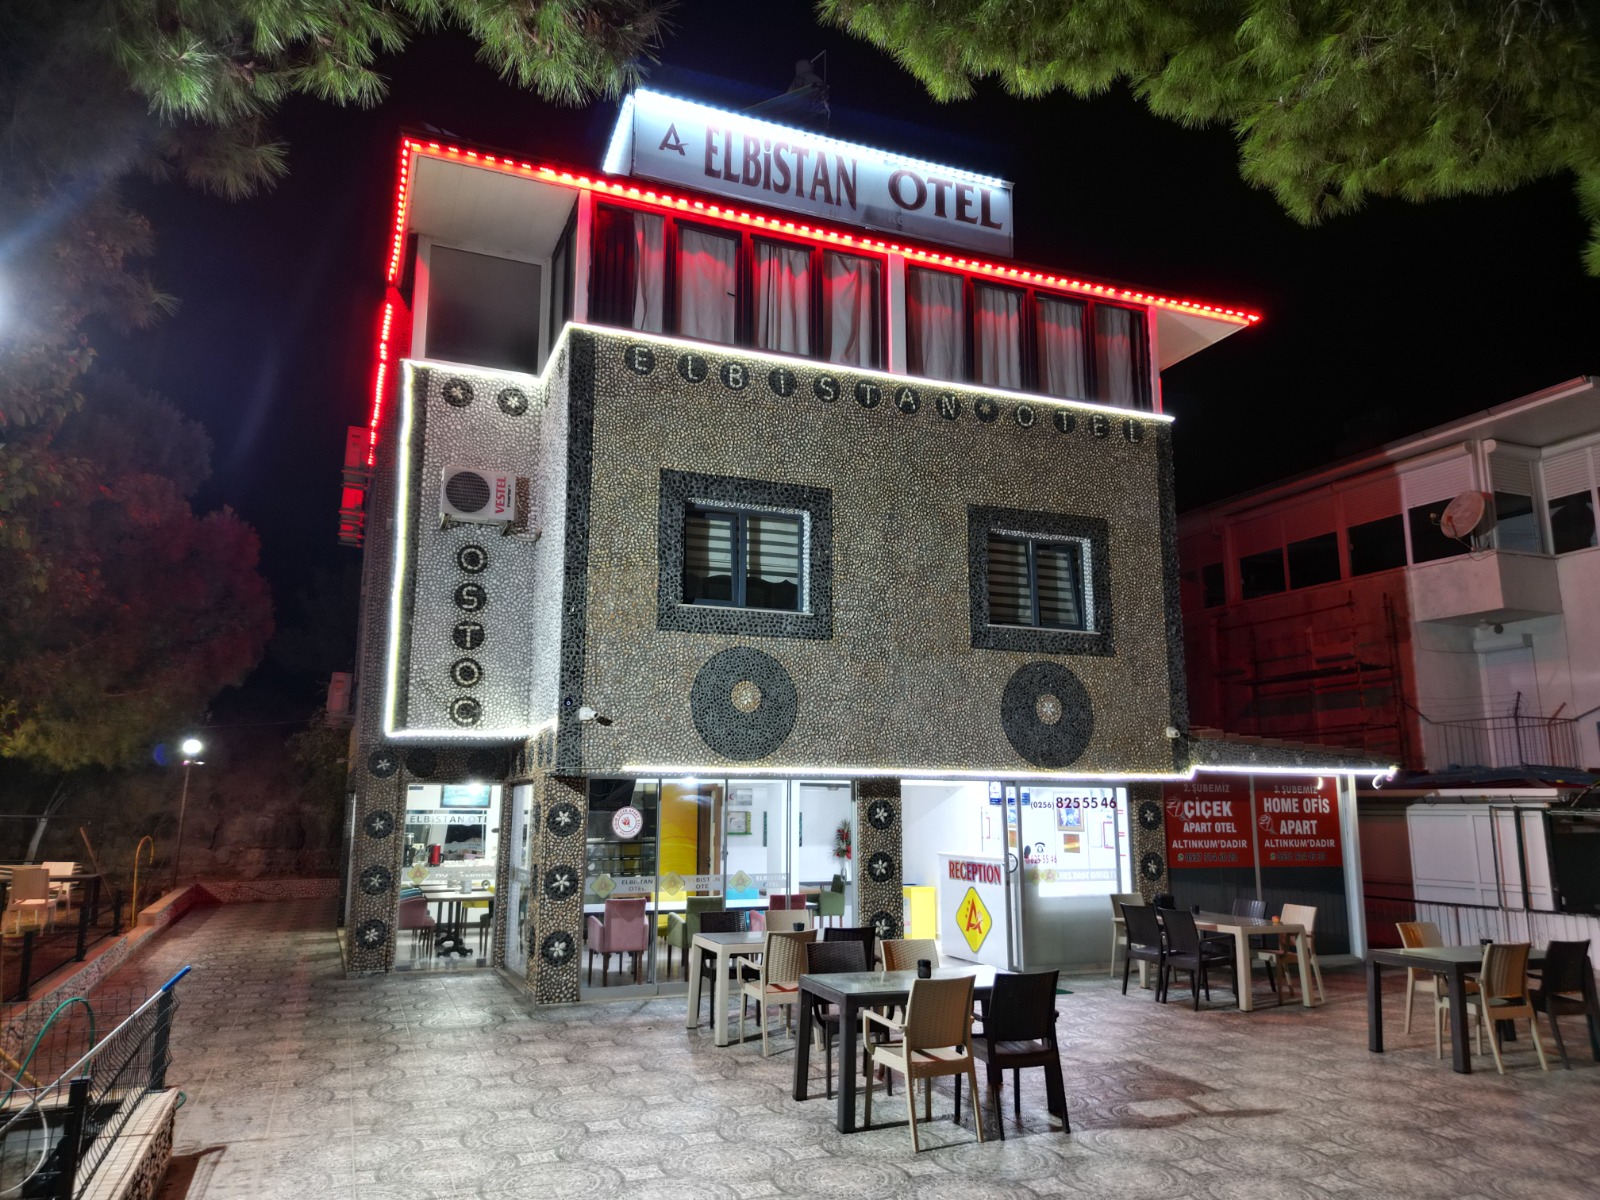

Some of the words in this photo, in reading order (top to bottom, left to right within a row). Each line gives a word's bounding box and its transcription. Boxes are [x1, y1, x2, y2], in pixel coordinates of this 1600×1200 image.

[887, 169, 1004, 231] OTEL
[1016, 403, 1139, 443] OTEL
[495, 476, 507, 514] VESTEL
[1030, 801, 1055, 810] (0256)
[1056, 796, 1080, 809] 825
[1082, 796, 1098, 809] 55
[1100, 796, 1117, 809] 46
[1183, 796, 1233, 819] ÇİÇEK
[1263, 797, 1300, 813] HOME
[1302, 794, 1331, 814] OFİS
[1183, 822, 1212, 833] APART
[1214, 822, 1237, 833] OTEL
[1279, 819, 1318, 835] APART
[948, 860, 1002, 886] RECEPTION
